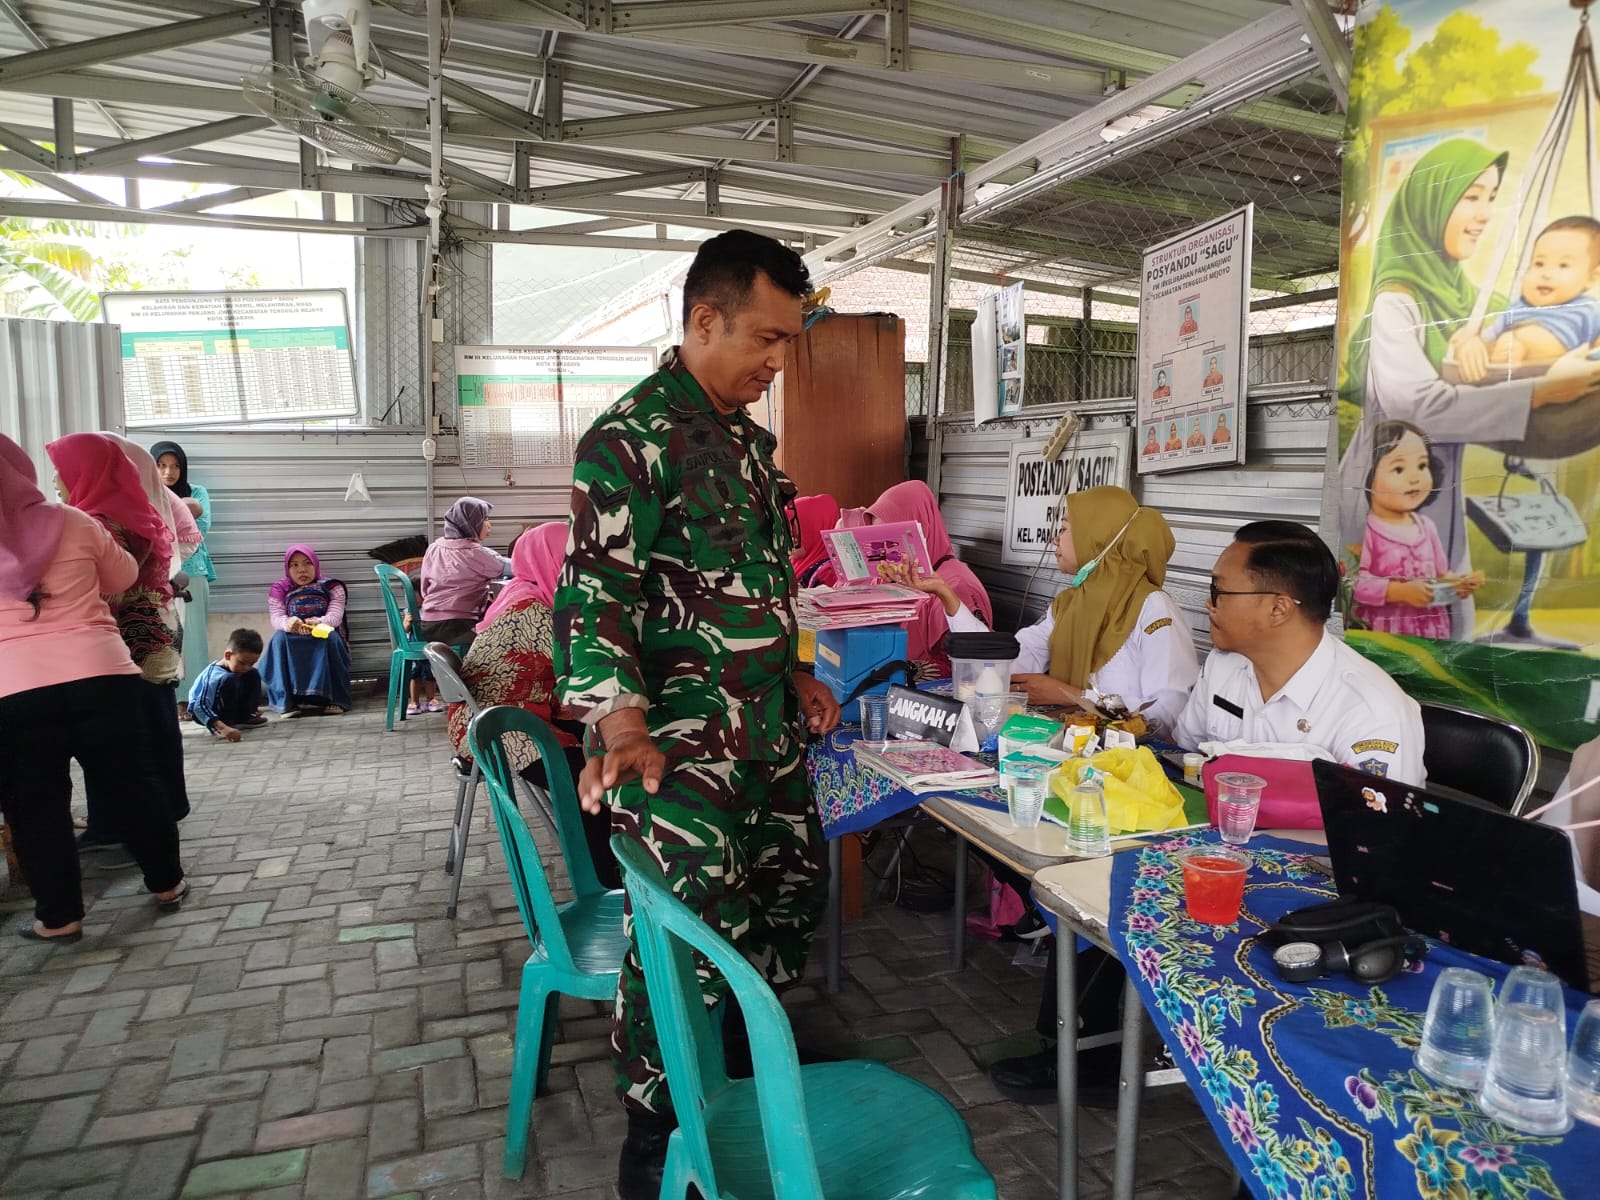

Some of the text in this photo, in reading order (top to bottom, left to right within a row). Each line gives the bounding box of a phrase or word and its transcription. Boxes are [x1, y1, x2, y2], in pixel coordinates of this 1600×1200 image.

[1152, 224, 1235, 266] STRUKTUR ORGANISASI
[1146, 252, 1198, 282] POSYANDU
[1208, 265, 1231, 280] MEJOYO
[1018, 459, 1071, 497] POSYANDU
[1017, 527, 1034, 543] KEL.
[889, 696, 957, 732] LANGKAH 4
